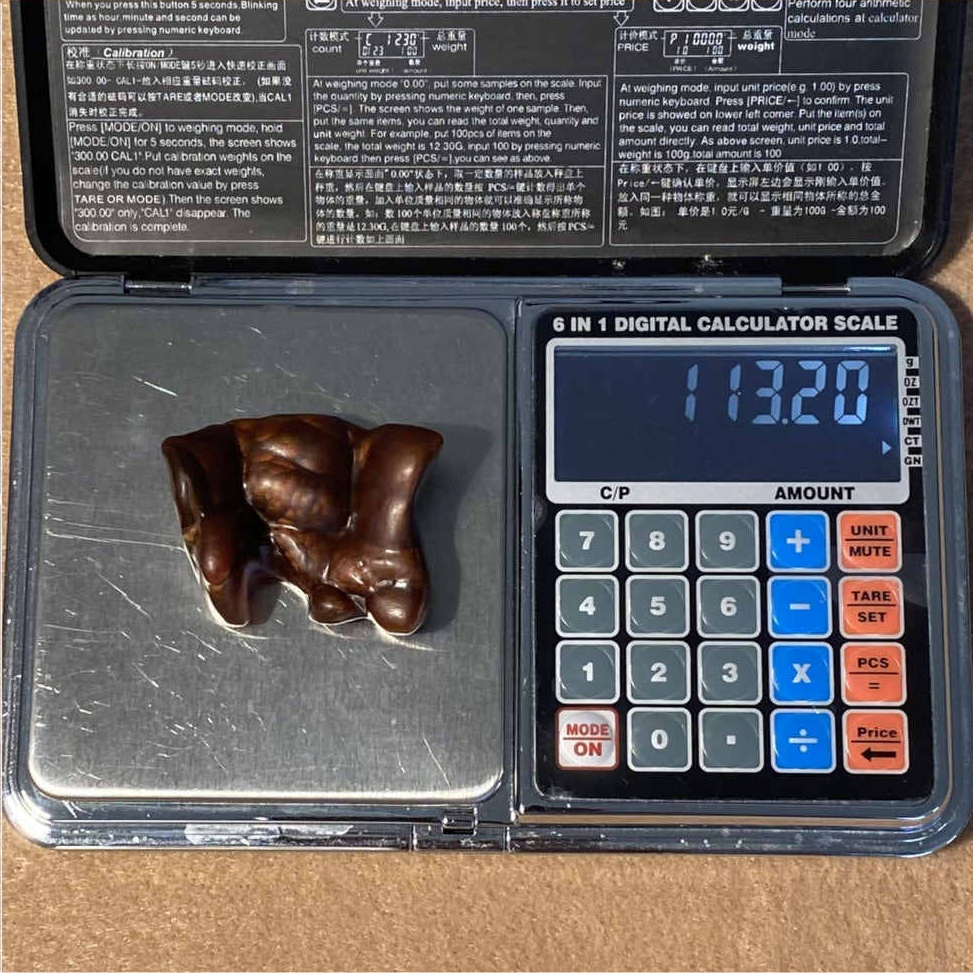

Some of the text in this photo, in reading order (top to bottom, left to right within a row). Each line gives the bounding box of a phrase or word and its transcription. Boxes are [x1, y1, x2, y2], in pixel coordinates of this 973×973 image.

[65, 0, 92, 9] When
[94, 2, 111, 10] you
[113, 2, 139, 10] press
[141, 0, 158, 9] this
[160, 0, 189, 9] button
[191, 1, 197, 9] 5
[64, 13, 84, 21] time
[156, 13, 173, 21] and
[175, 13, 208, 21] second
[229, 13, 241, 21] be
[787, 12, 919, 23] calculations at calculator
[65, 26, 102, 35] updated
[104, 26, 115, 35] by
[117, 26, 157, 35] pressing
[159, 26, 196, 34] numeric
[436, 30, 467, 41] 总重量
[619, 31, 658, 40] 计价模式
[742, 30, 773, 40] 总重量
[787, 28, 816, 38] mode
[309, 32, 349, 42] 计数模式
[312, 45, 342, 53] count
[432, 42, 467, 53] weight
[617, 43, 649, 51] PRICE
[313, 92, 328, 101] the
[330, 92, 368, 103] quantity
[370, 92, 382, 103] by
[385, 92, 425, 103] pressing
[428, 92, 466, 100] numeric
[540, 93, 565, 102] press
[619, 110, 643, 122] price
[647, 111, 655, 120] is
[658, 110, 697, 120] showed
[699, 111, 712, 119] on
[715, 110, 742, 119] lower
[745, 109, 760, 119] left
[799, 109, 815, 119] Put
[817, 109, 832, 118] the
[834, 109, 867, 119] item(s)
[869, 110, 881, 118] on
[69, 122, 283, 135] Press [MODE/ON] to weighing mode, hold
[70, 137, 297, 148] [MODE/ON] for 5 seconds, the screen shows
[553, 315, 898, 332] 6 IN 1 DIGITAL CALCULATOR SCALE
[906, 358, 913, 367] g
[685, 360, 870, 425] 113.20
[904, 437, 919, 445] CT
[904, 457, 921, 465] GN
[600, 486, 855, 501] C/P AMOUNT
[851, 526, 887, 536] UNIT
[579, 531, 595, 550] 7
[648, 531, 665, 551] 8
[719, 531, 736, 550] 9
[849, 546, 891, 557] MUTE
[851, 591, 891, 601] TARE
[579, 597, 596, 615] 4
[650, 596, 666, 615] 5
[721, 596, 737, 616] 6
[858, 612, 886, 622] SET
[857, 658, 889, 669] PCS
[582, 662, 593, 681] 1
[651, 663, 667, 682] 2
[722, 663, 738, 683] 3
[566, 724, 608, 736] MODE
[857, 727, 898, 739] Price
[652, 730, 667, 749] 0
[574, 742, 602, 757] ON
